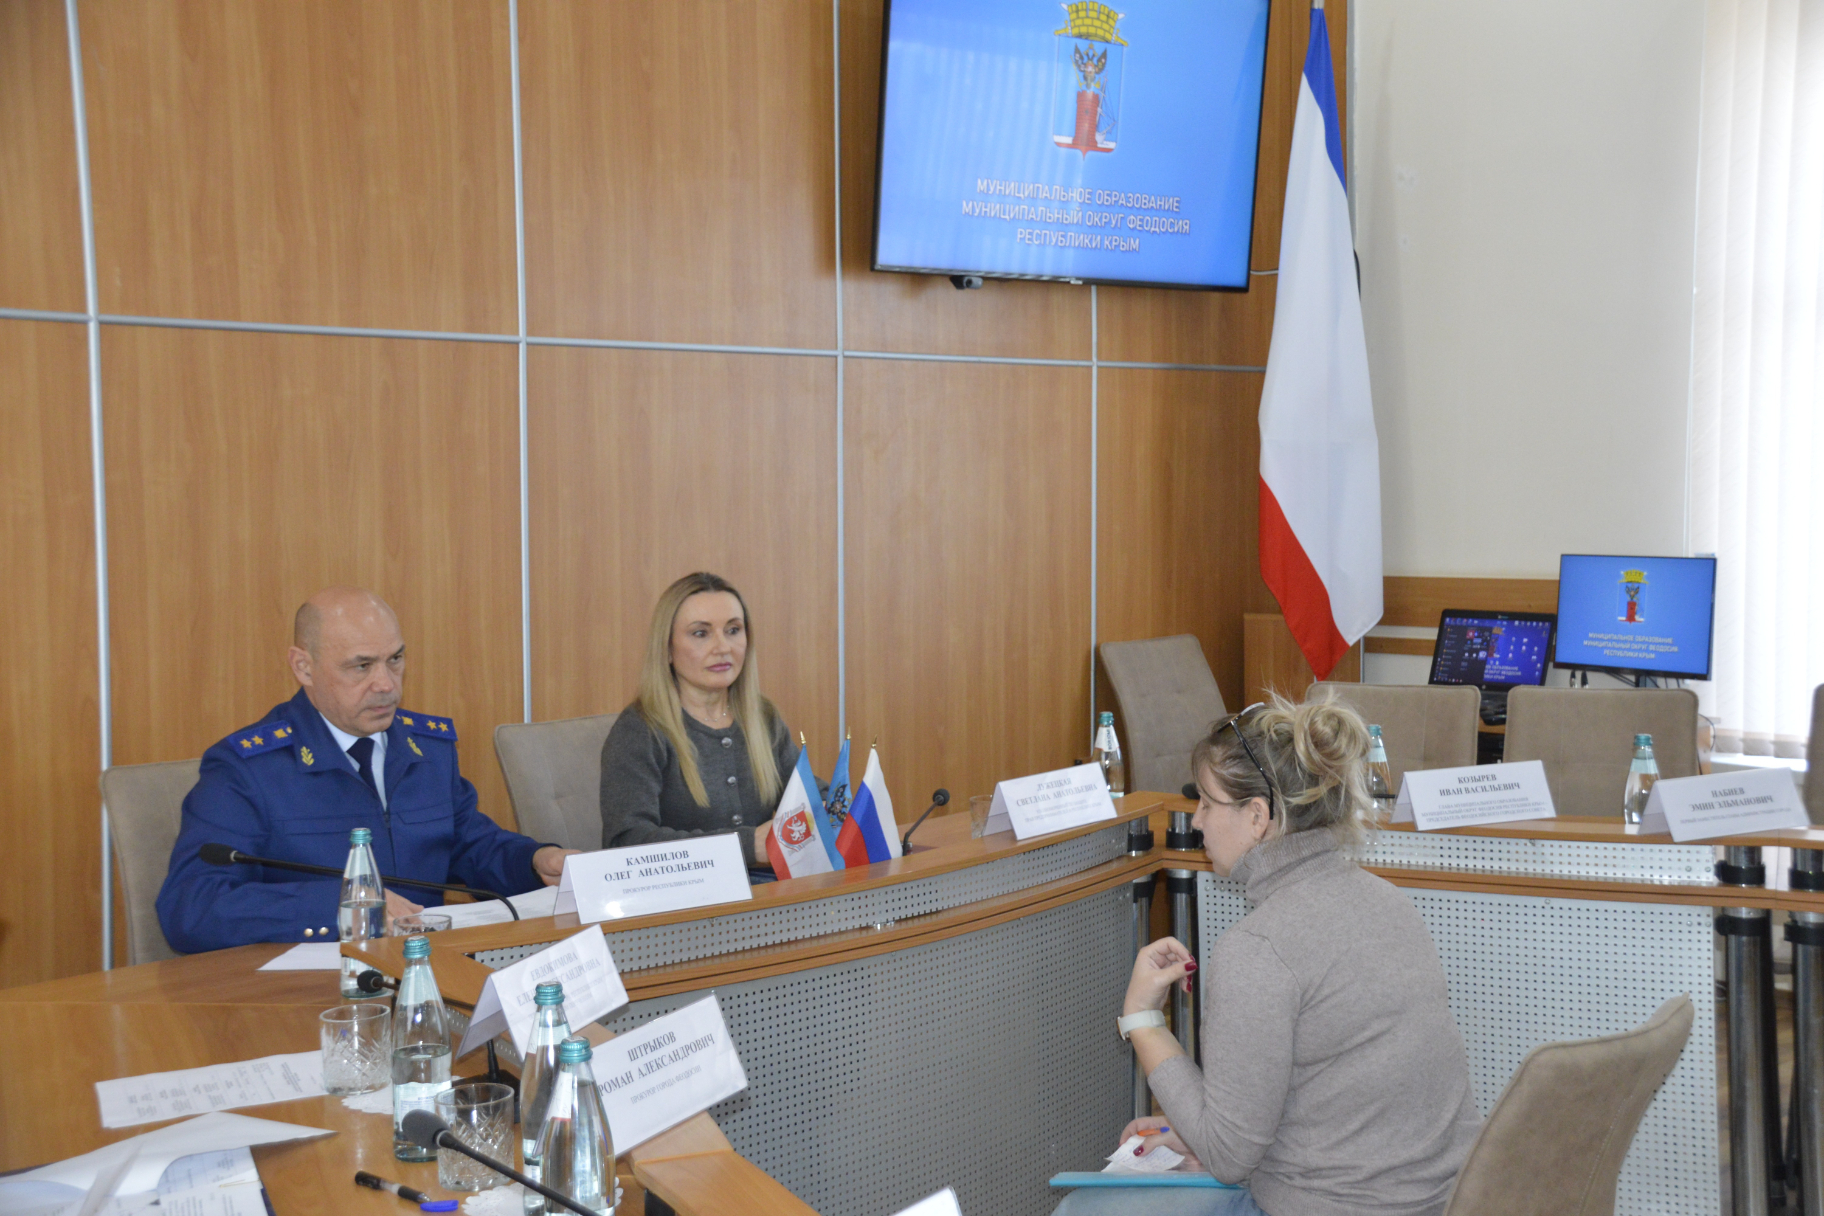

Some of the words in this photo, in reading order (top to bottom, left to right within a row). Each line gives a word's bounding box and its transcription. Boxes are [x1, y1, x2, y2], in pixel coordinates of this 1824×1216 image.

[977, 178, 1092, 204] МУНИЦИПАЛЬНОЕ
[1095, 190, 1180, 212] ОБРАЗОВАНИЕ
[962, 200, 1083, 225] МУНИЦИПАЛЬНЫЙ
[1085, 211, 1124, 229] ОКРУГ
[1126, 215, 1190, 235] ФЕОДОСИЯ
[1017, 228, 1101, 249] РЕСПУБЛИКИ
[1104, 236, 1140, 252] КРЫМ
[1037, 778, 1072, 791] ЛУЖЕЦКАЯ
[1439, 787, 1463, 797] ИВАН
[1464, 782, 1521, 794] ВАСИЛЬЕВИЧ
[1458, 774, 1497, 784] КОЗЫРЕВ
[1016, 794, 1051, 807] СВЕТЛАНА
[1053, 784, 1098, 798] АНАТОЛЬЕВНА
[1689, 802, 1715, 812] ЭМИН
[1716, 795, 1773, 809] ЭЛЬМАНОВИЧ
[1711, 787, 1745, 798] НАБИЕВ
[626, 850, 689, 866] КАМШИЛОВ
[604, 870, 633, 882] ОЛЕГ
[638, 859, 715, 878] АНАТОЛЬЕВИЧ
[622, 885, 651, 895] ПРОКУРОР
[652, 880, 687, 890] РЕСПУБЛИКИ
[530, 952, 578, 981] ЕВДОКИМОВА
[627, 1031, 677, 1062] ШТРЫКОВ
[597, 1070, 634, 1097] РОМАН
[638, 1033, 715, 1079] АЛЕКСАНДРОВИЧ
[630, 1087, 657, 1104] ПРОКУРОР
[655, 1078, 677, 1092] ГОРОДА
